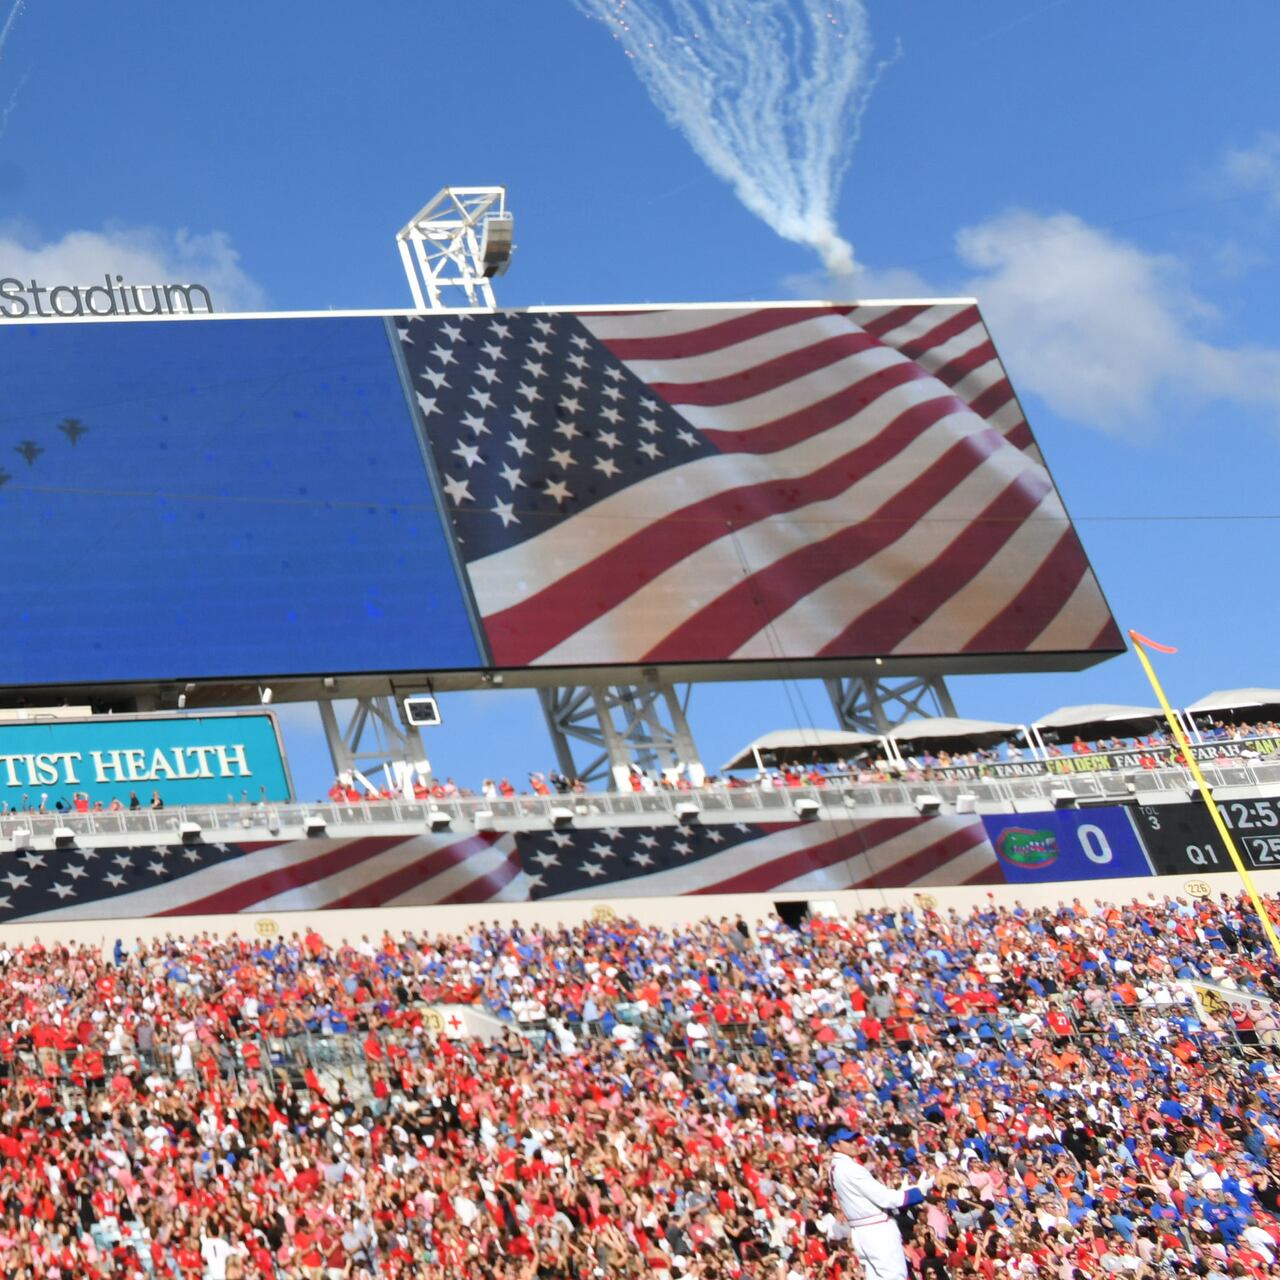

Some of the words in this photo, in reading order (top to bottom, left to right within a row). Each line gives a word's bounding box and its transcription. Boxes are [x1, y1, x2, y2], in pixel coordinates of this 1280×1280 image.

[89, 744, 251, 783] HEALTH
[1138, 806, 1159, 815] TOL
[1217, 801, 1280, 829] 12:5
[1148, 816, 1161, 830] 3
[1077, 824, 1113, 865] 0
[1186, 844, 1219, 865] Q1
[1187, 883, 1208, 893] 226
